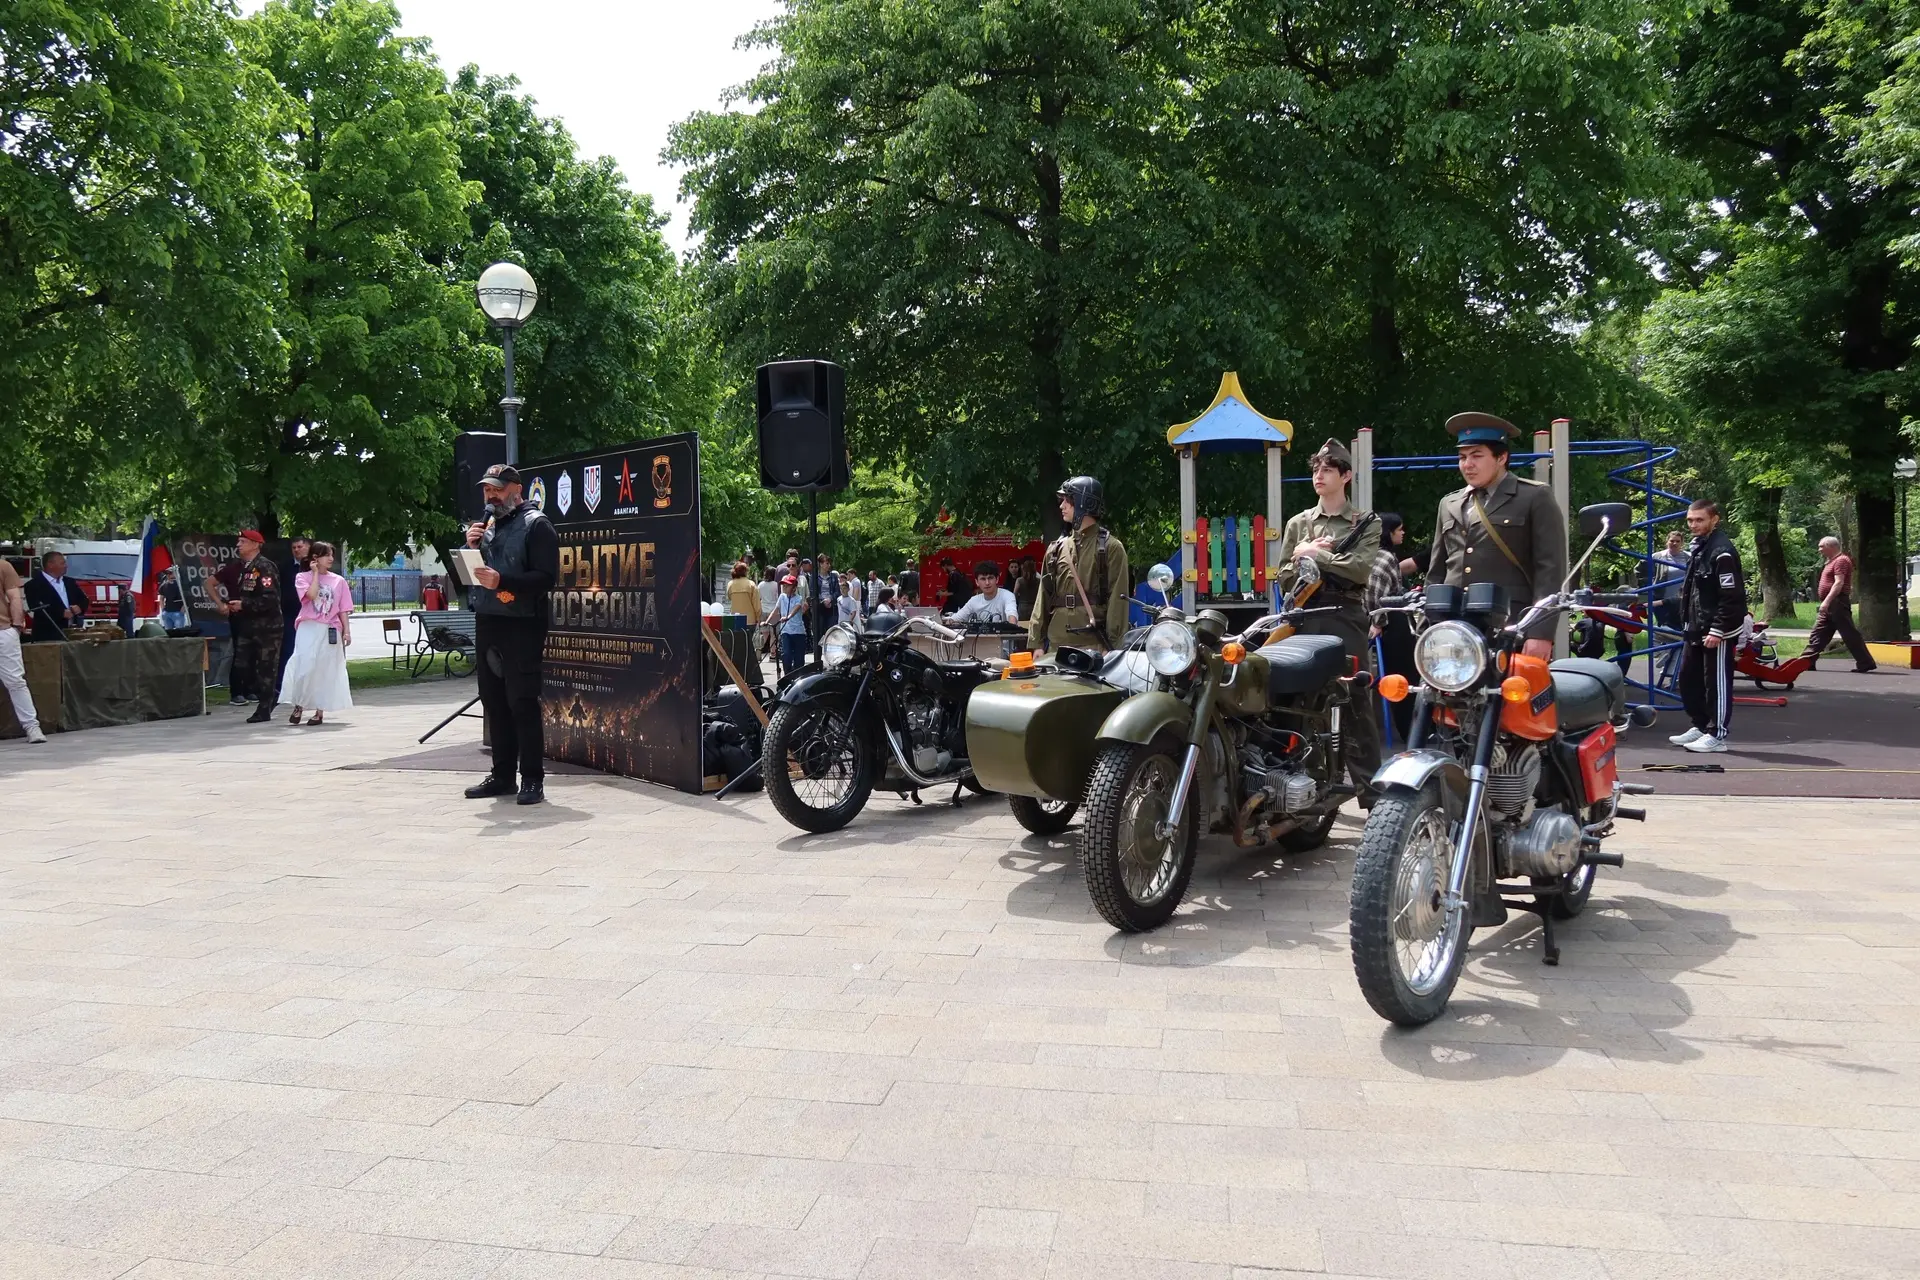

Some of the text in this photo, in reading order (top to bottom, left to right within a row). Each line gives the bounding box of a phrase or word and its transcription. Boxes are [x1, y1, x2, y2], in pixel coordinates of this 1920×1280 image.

[614, 507, 639, 515] АВАНГАРД
[183, 541, 240, 561] Сборк
[555, 542, 656, 588] РЫТИЕ
[1720, 575, 1734, 586] Z
[548, 591, 660, 630] ОСЕЗОНА
[571, 637, 599, 649] ЕДИНСТВА
[601, 639, 628, 651] НАРОДОВ
[630, 641, 654, 654] РОССИИ
[549, 648, 583, 660] СЛАВЯНСКОЙ
[585, 651, 632, 665] ПИСЬМЕННОСТИ
